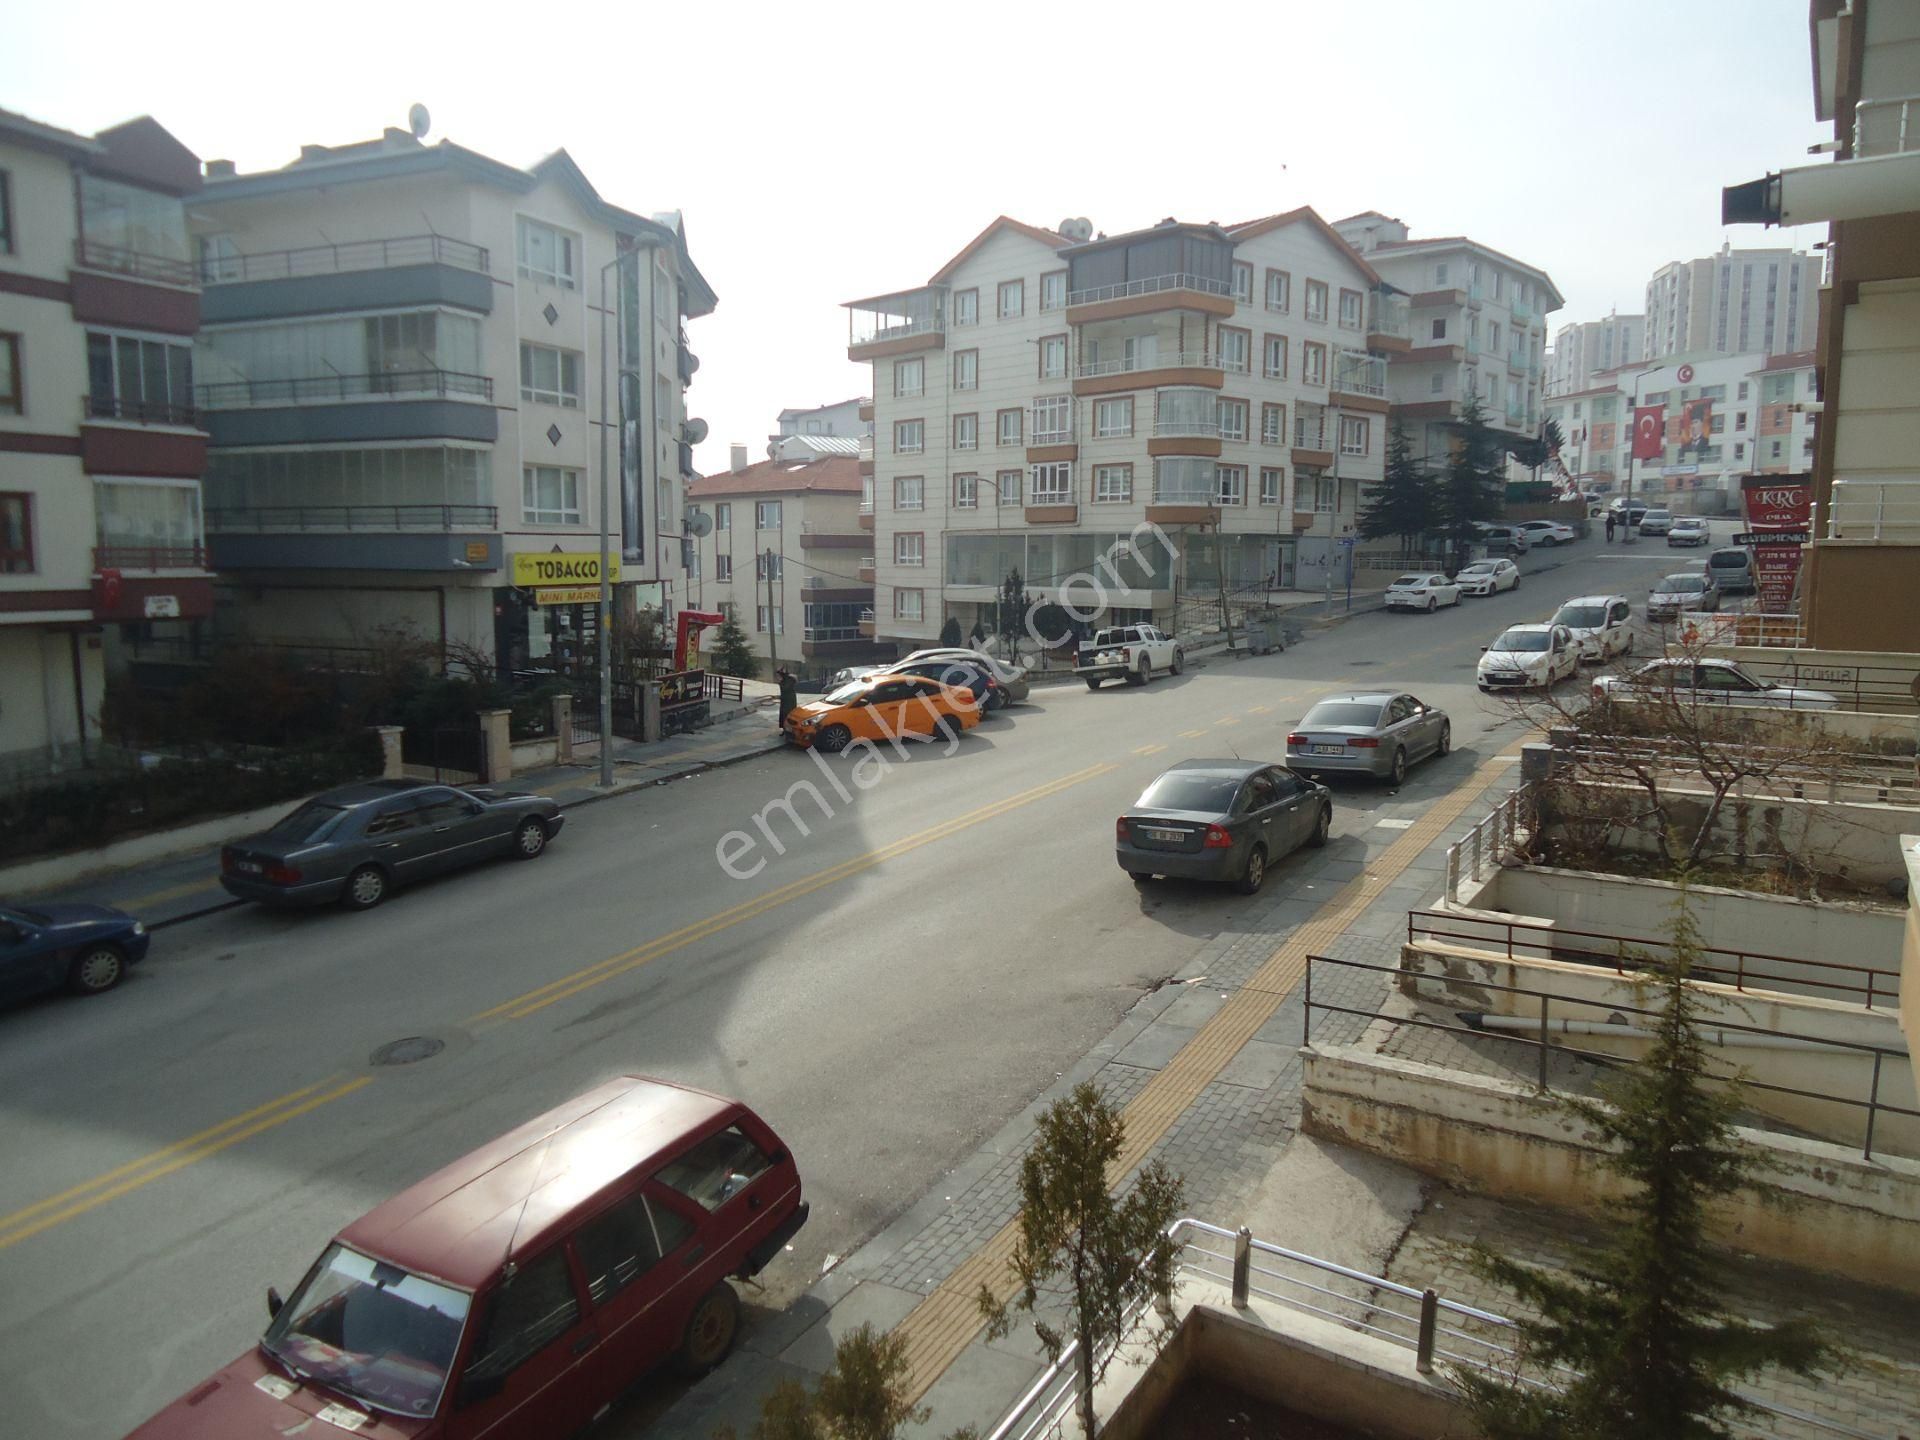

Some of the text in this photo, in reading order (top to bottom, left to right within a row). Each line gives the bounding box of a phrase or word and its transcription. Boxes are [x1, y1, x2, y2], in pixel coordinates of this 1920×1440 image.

[1755, 490, 1804, 509] KRC
[535, 560, 599, 578] TOBACCO
[567, 590, 602, 602] MARKE
